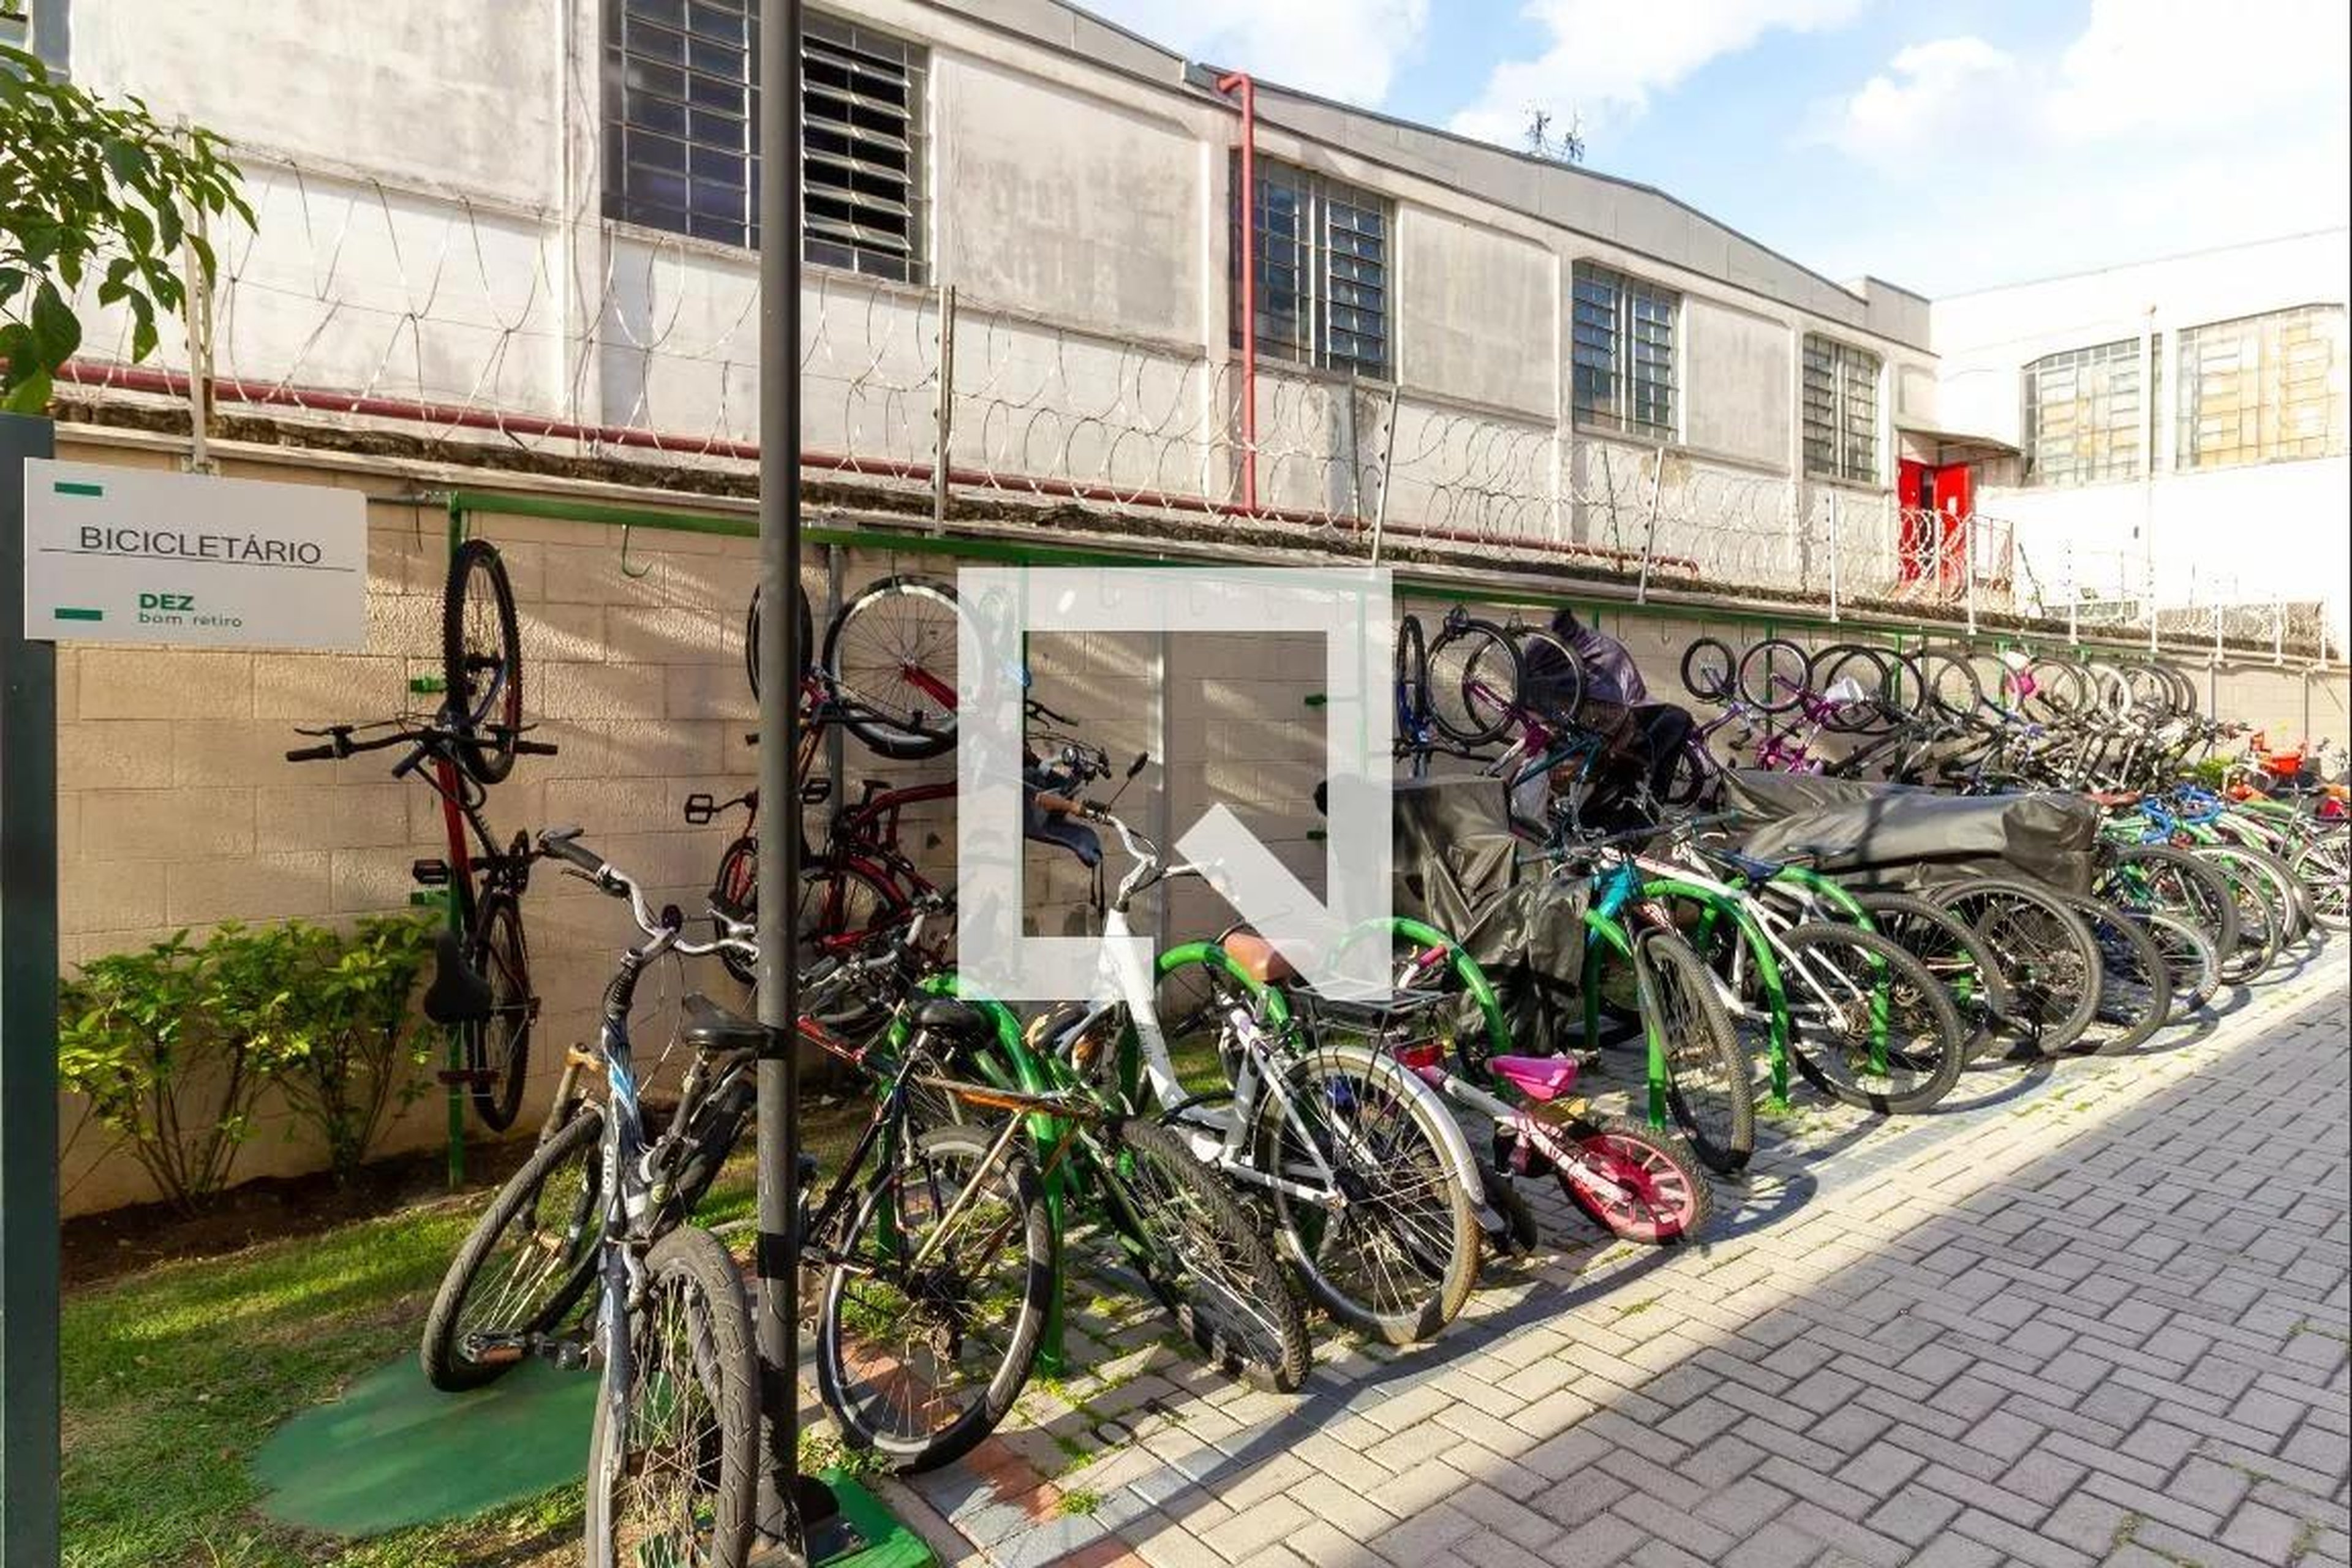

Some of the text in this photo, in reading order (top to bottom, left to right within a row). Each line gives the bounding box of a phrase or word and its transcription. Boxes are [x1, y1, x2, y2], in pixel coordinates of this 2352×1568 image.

[80, 526, 322, 565] BICICLETÁRIO
[139, 593, 195, 611] DEZ
[138, 612, 243, 628] bom retiro
[602, 1144, 613, 1193] CALOI
